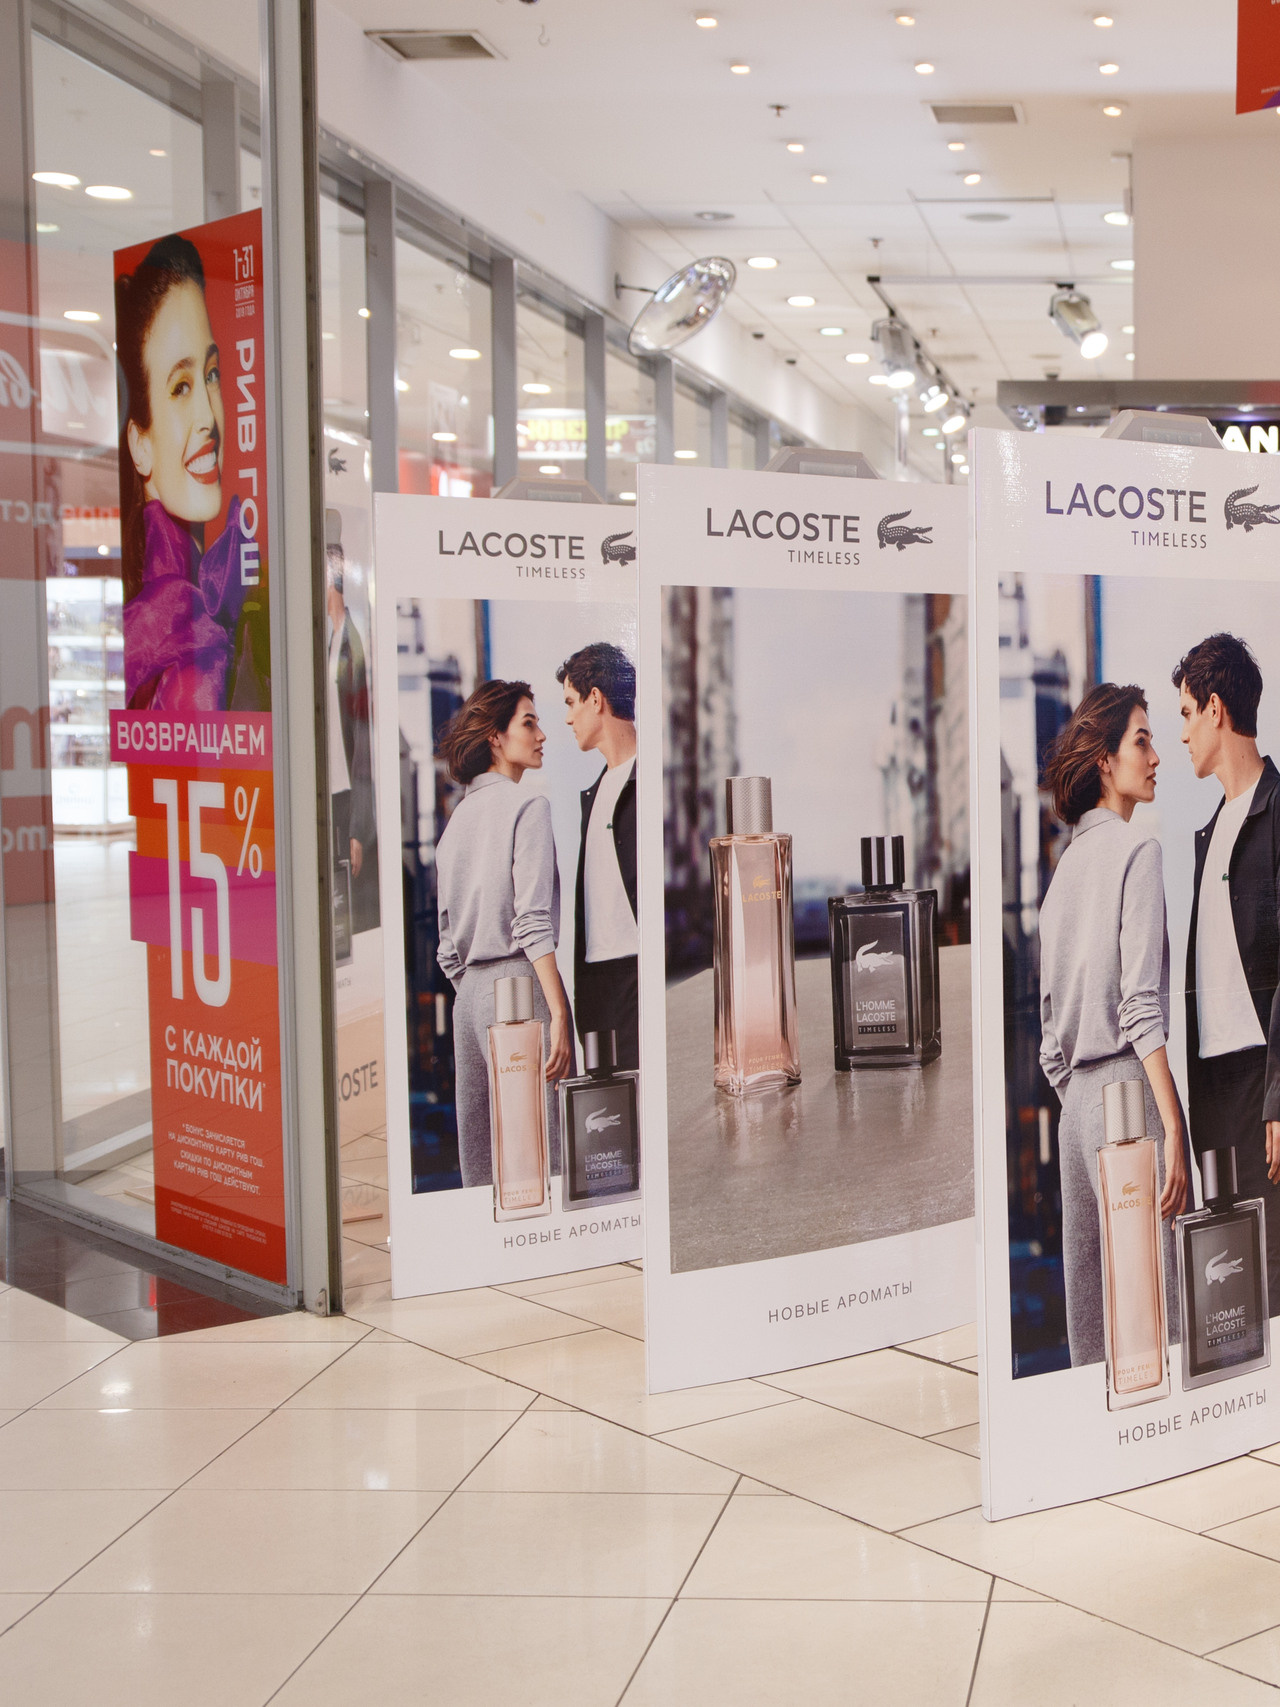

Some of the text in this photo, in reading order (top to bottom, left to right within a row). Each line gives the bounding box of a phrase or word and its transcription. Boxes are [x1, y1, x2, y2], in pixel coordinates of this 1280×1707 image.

[236, 337, 260, 587] РИВ ГОШ
[1045, 480, 1208, 524] LACOSTE
[706, 507, 861, 544] LACOSTE
[438, 530, 586, 561] LACOSTE
[1131, 530, 1208, 549] TIMELESS
[787, 549, 861, 566] TIMELESS
[516, 565, 587, 580] TIMELESS
[116, 720, 265, 760] ВОЗВРАЩАЕМ
[741, 889, 783, 904] LACOSTE
[855, 999, 897, 1012] L'HOMME
[856, 1011, 897, 1024] LACOSTE
[858, 1024, 897, 1033] TIMELESS
[164, 1024, 263, 1074] С КАЖДОЙ
[338, 1060, 378, 1103] OSTE
[584, 1150, 623, 1163] L'HOMME
[585, 1159, 624, 1172] LACOSTE
[503, 1213, 642, 1249] НОВЫЕ АРОМАТЫ
[768, 1280, 913, 1324] НОВЫЕ АРОМАТЫ
[1205, 1305, 1246, 1325] L'HOMME
[1206, 1318, 1247, 1337] LACOSTE
[1117, 1370, 1154, 1386] TIMELES
[1118, 1389, 1267, 1446] НОВЫЕ АРОМАТЫ
